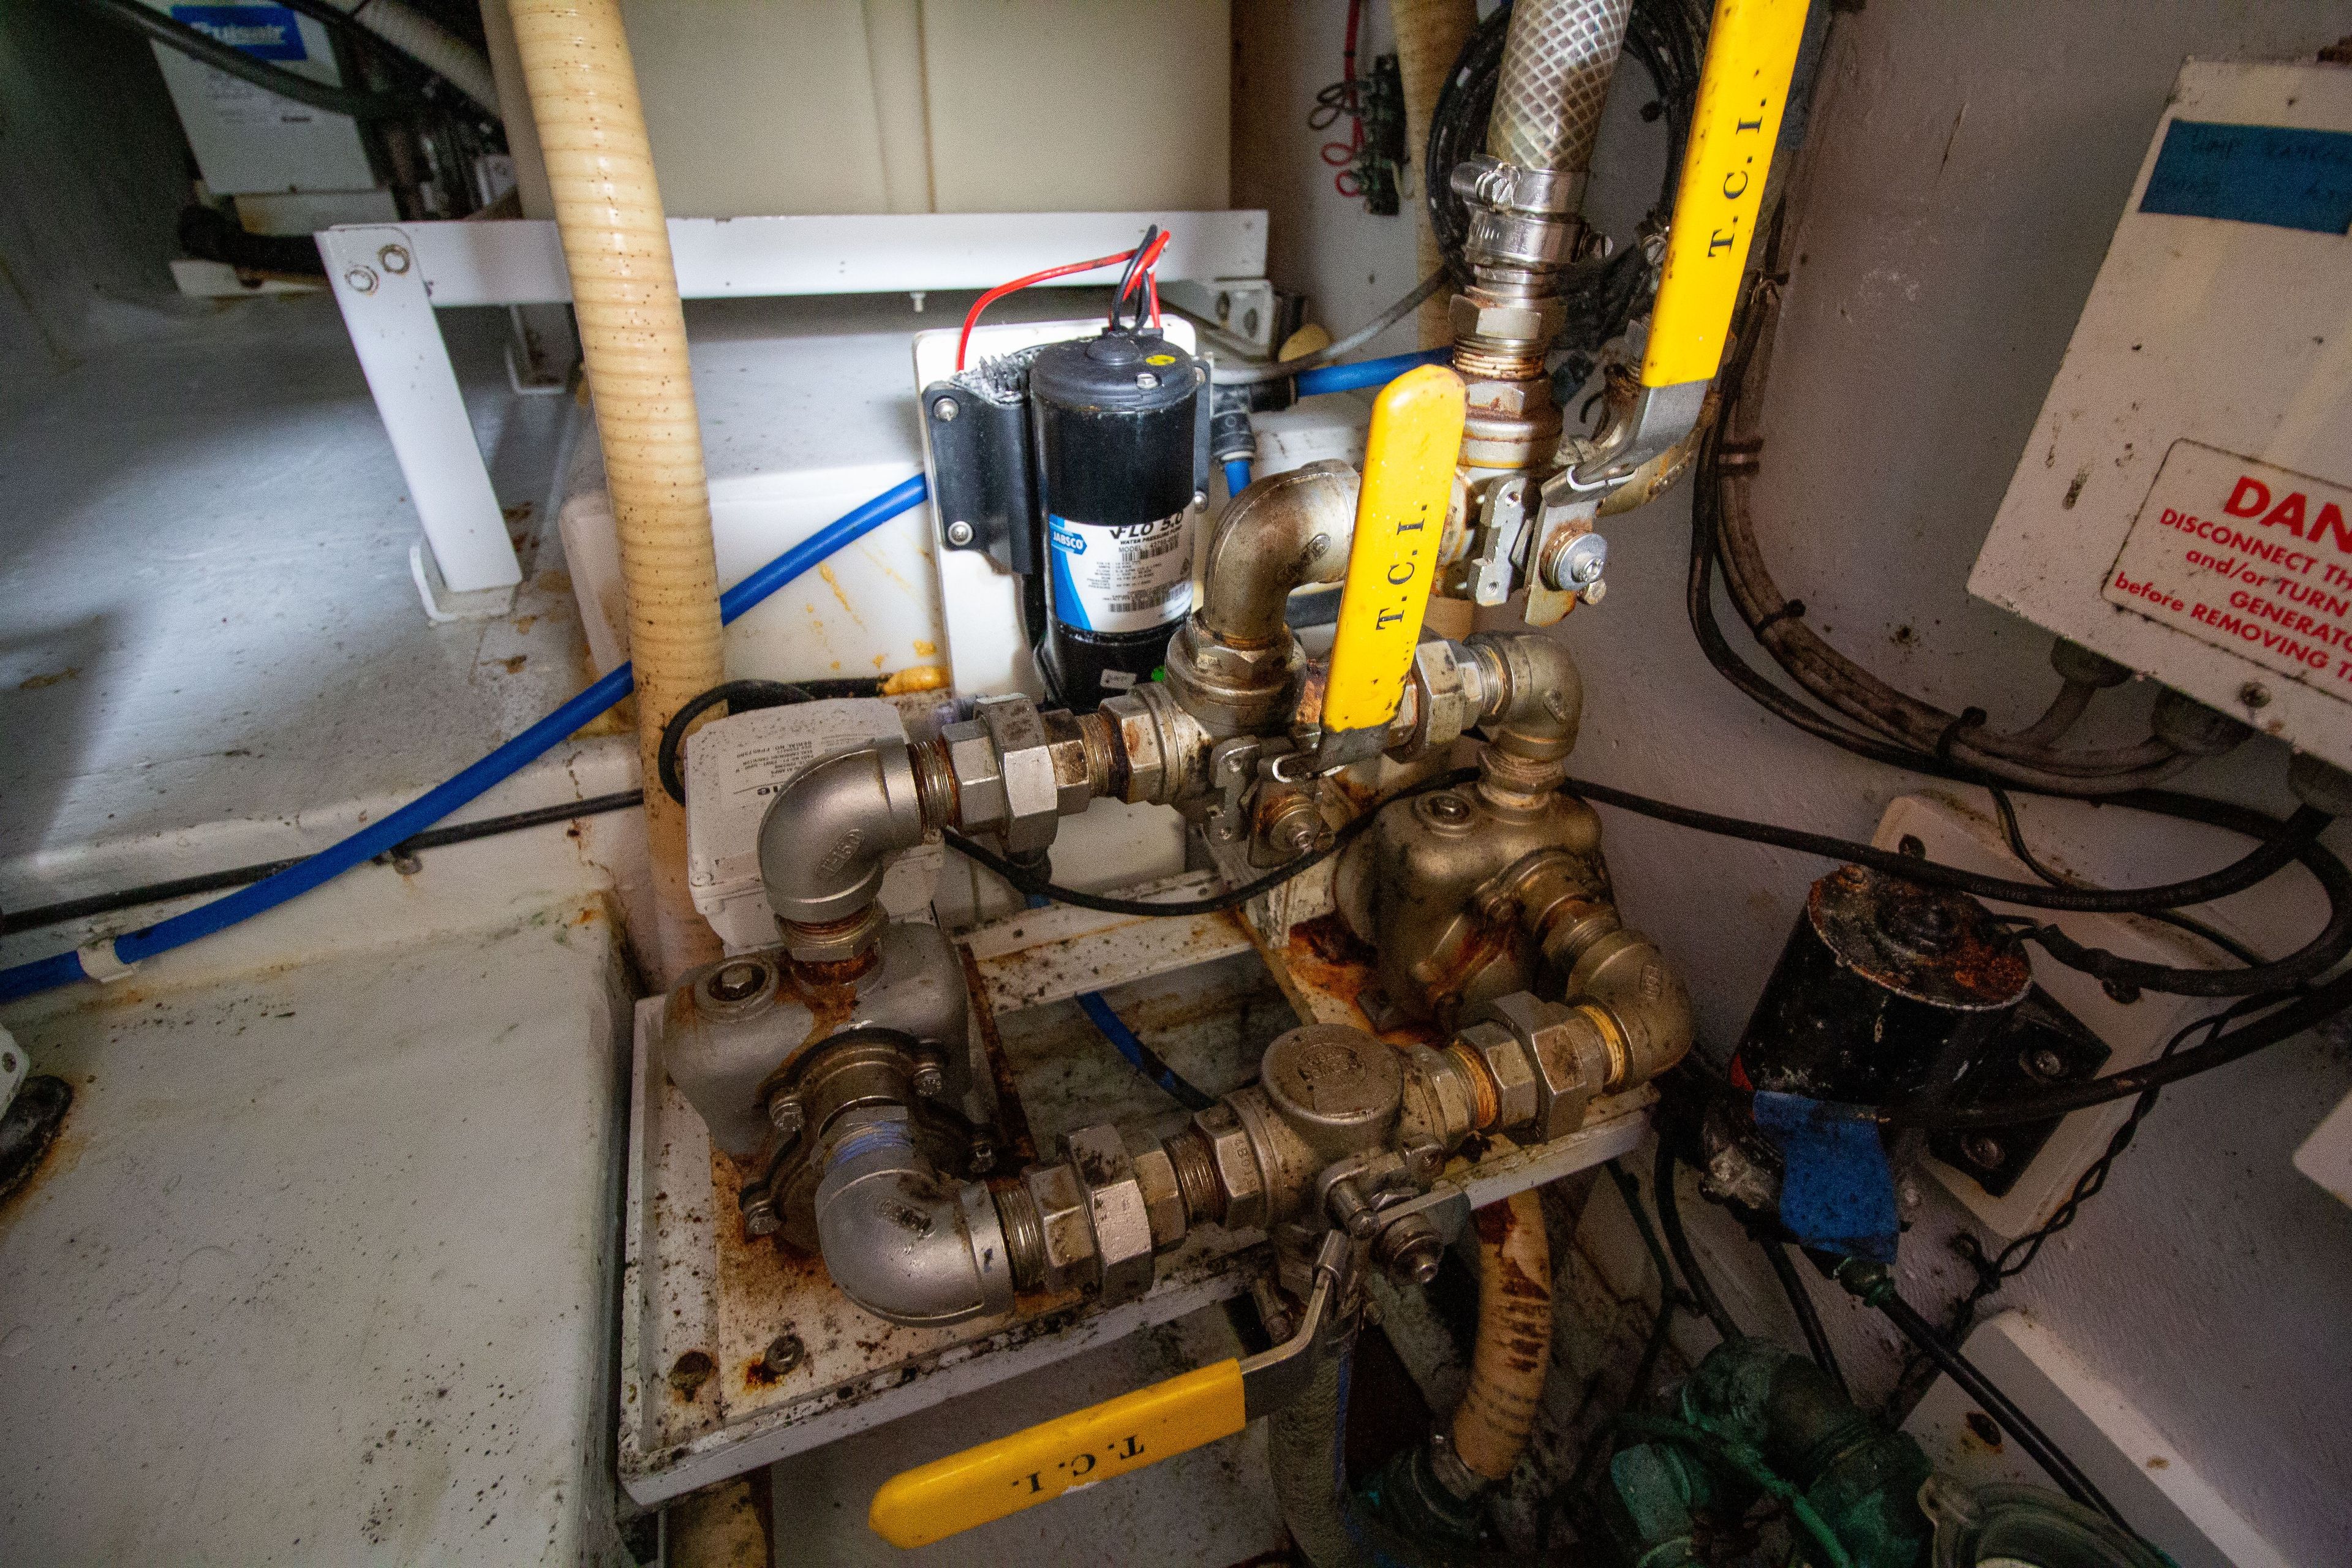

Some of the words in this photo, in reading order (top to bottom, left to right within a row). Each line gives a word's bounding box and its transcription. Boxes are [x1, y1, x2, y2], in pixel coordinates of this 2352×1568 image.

[1053, 530, 1084, 550] JABSCO
[2160, 508, 2318, 575] DISCONNECT
[2186, 549, 2270, 587] and/or
[2277, 577, 2350, 617] TURN
[2114, 571, 2184, 611] before
[2190, 603, 2329, 669] REMOVING
